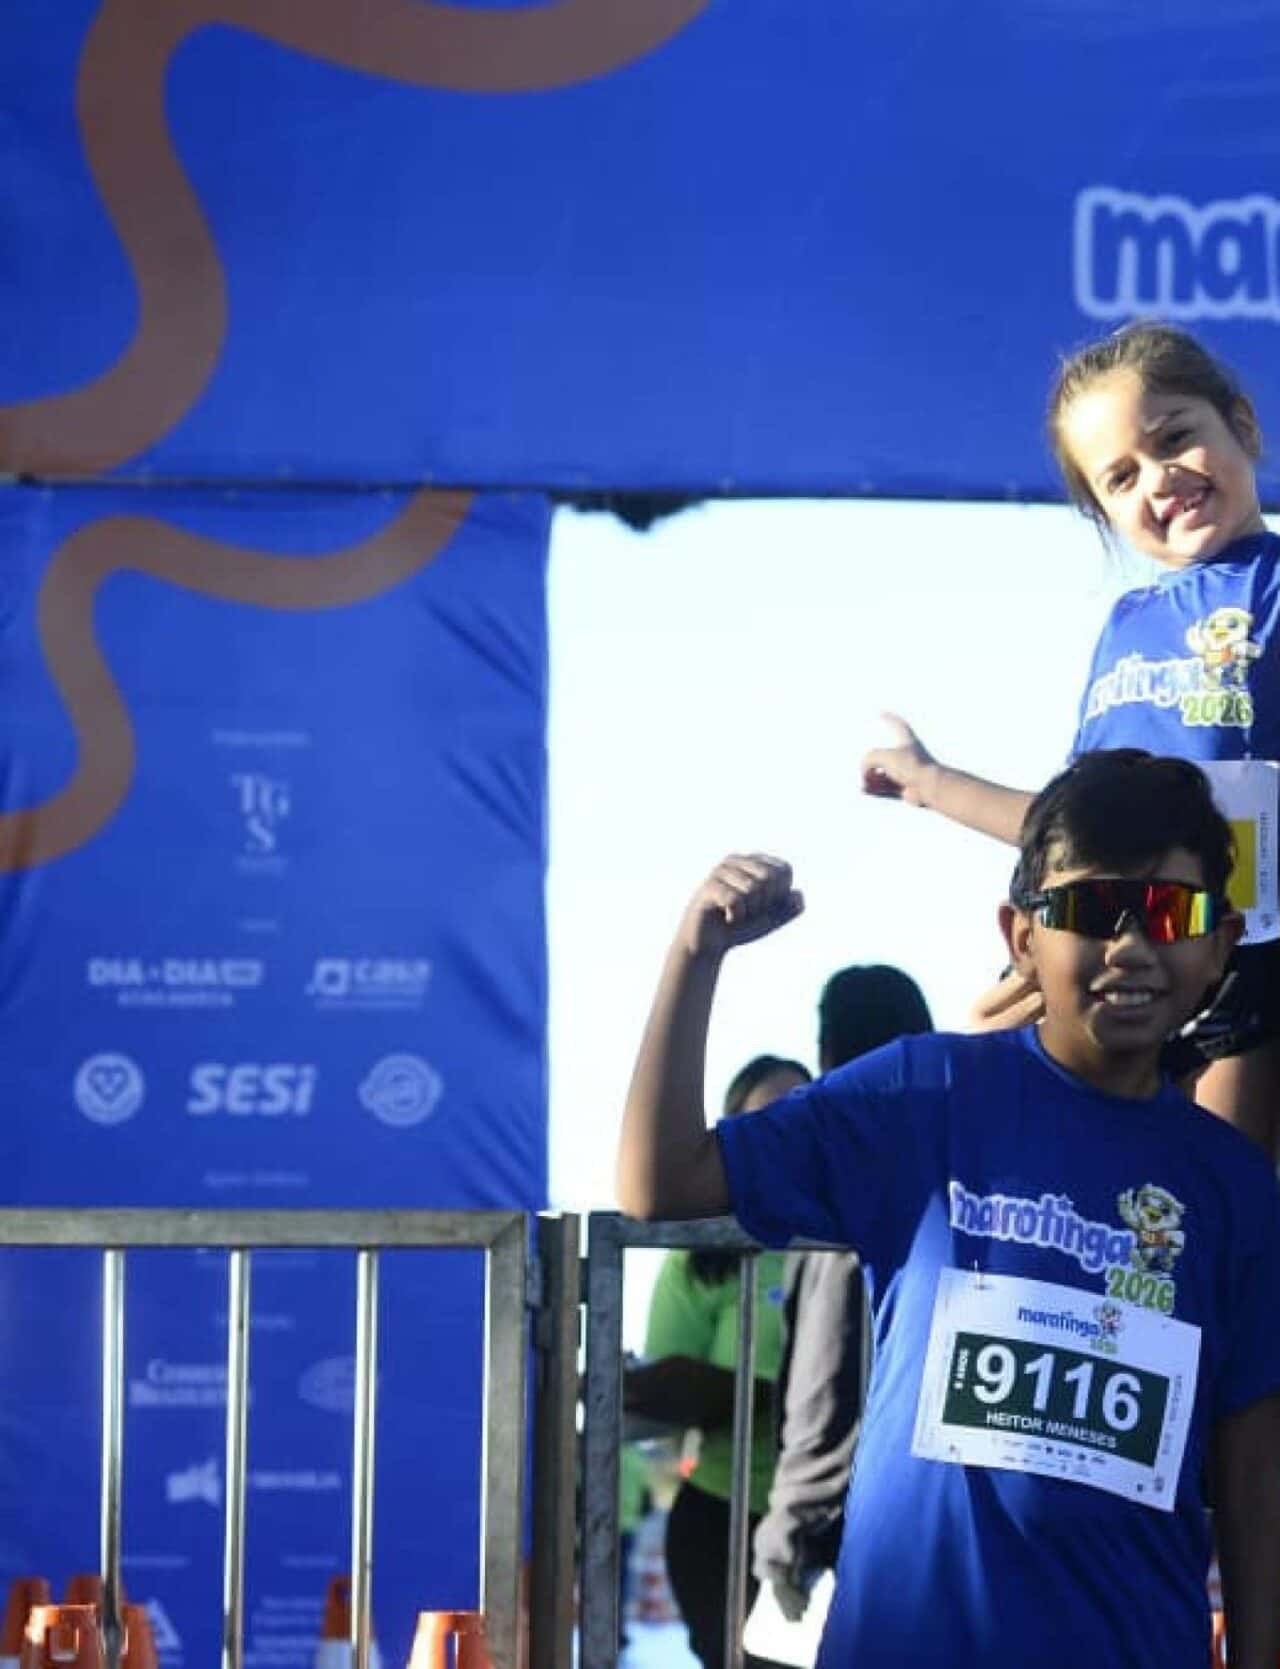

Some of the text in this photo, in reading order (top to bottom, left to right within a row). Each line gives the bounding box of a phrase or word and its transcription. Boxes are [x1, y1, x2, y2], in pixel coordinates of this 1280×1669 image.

[1181, 691, 1253, 727] 2026
[1105, 1269, 1175, 1312] 2026
[973, 1344, 1143, 1431] 9116
[986, 1410, 1118, 1449] HEITOR MENESES
